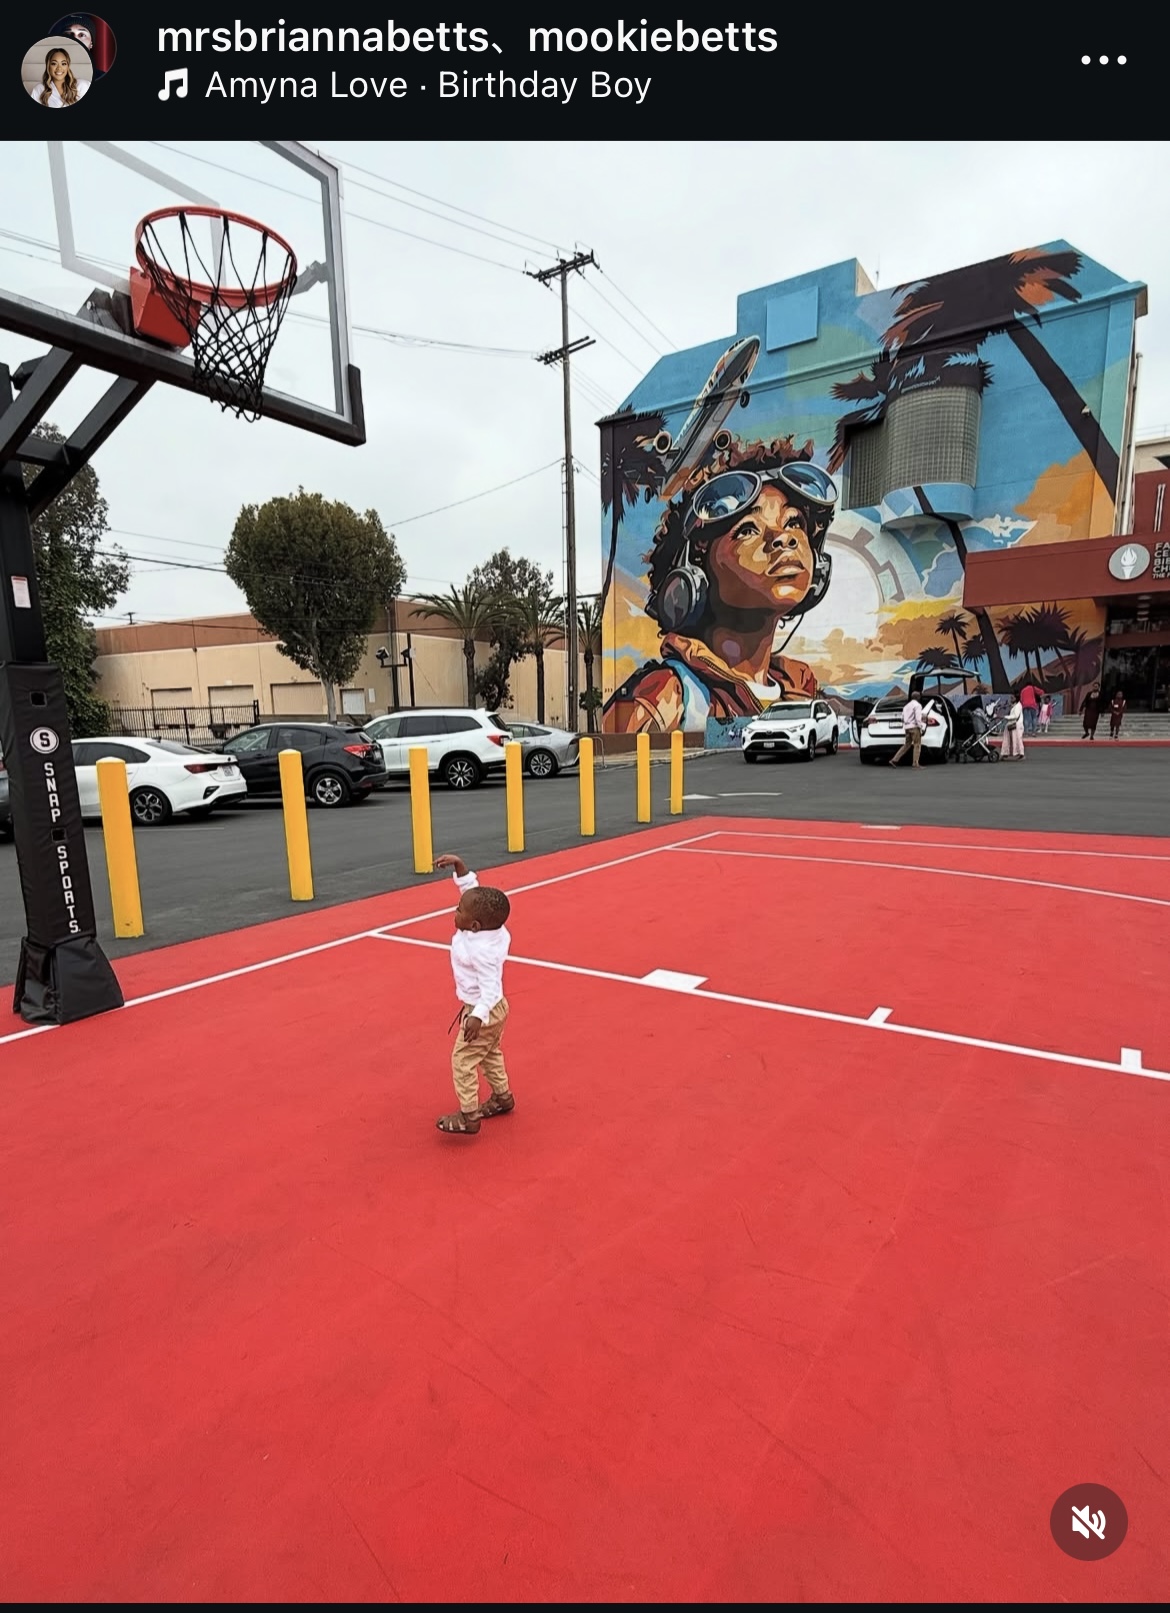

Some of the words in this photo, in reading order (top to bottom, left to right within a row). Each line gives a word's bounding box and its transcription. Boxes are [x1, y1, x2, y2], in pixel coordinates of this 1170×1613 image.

[1153, 565, 1170, 573] CH
[39, 731, 51, 748] S
[43, 762, 61, 823] SNAP
